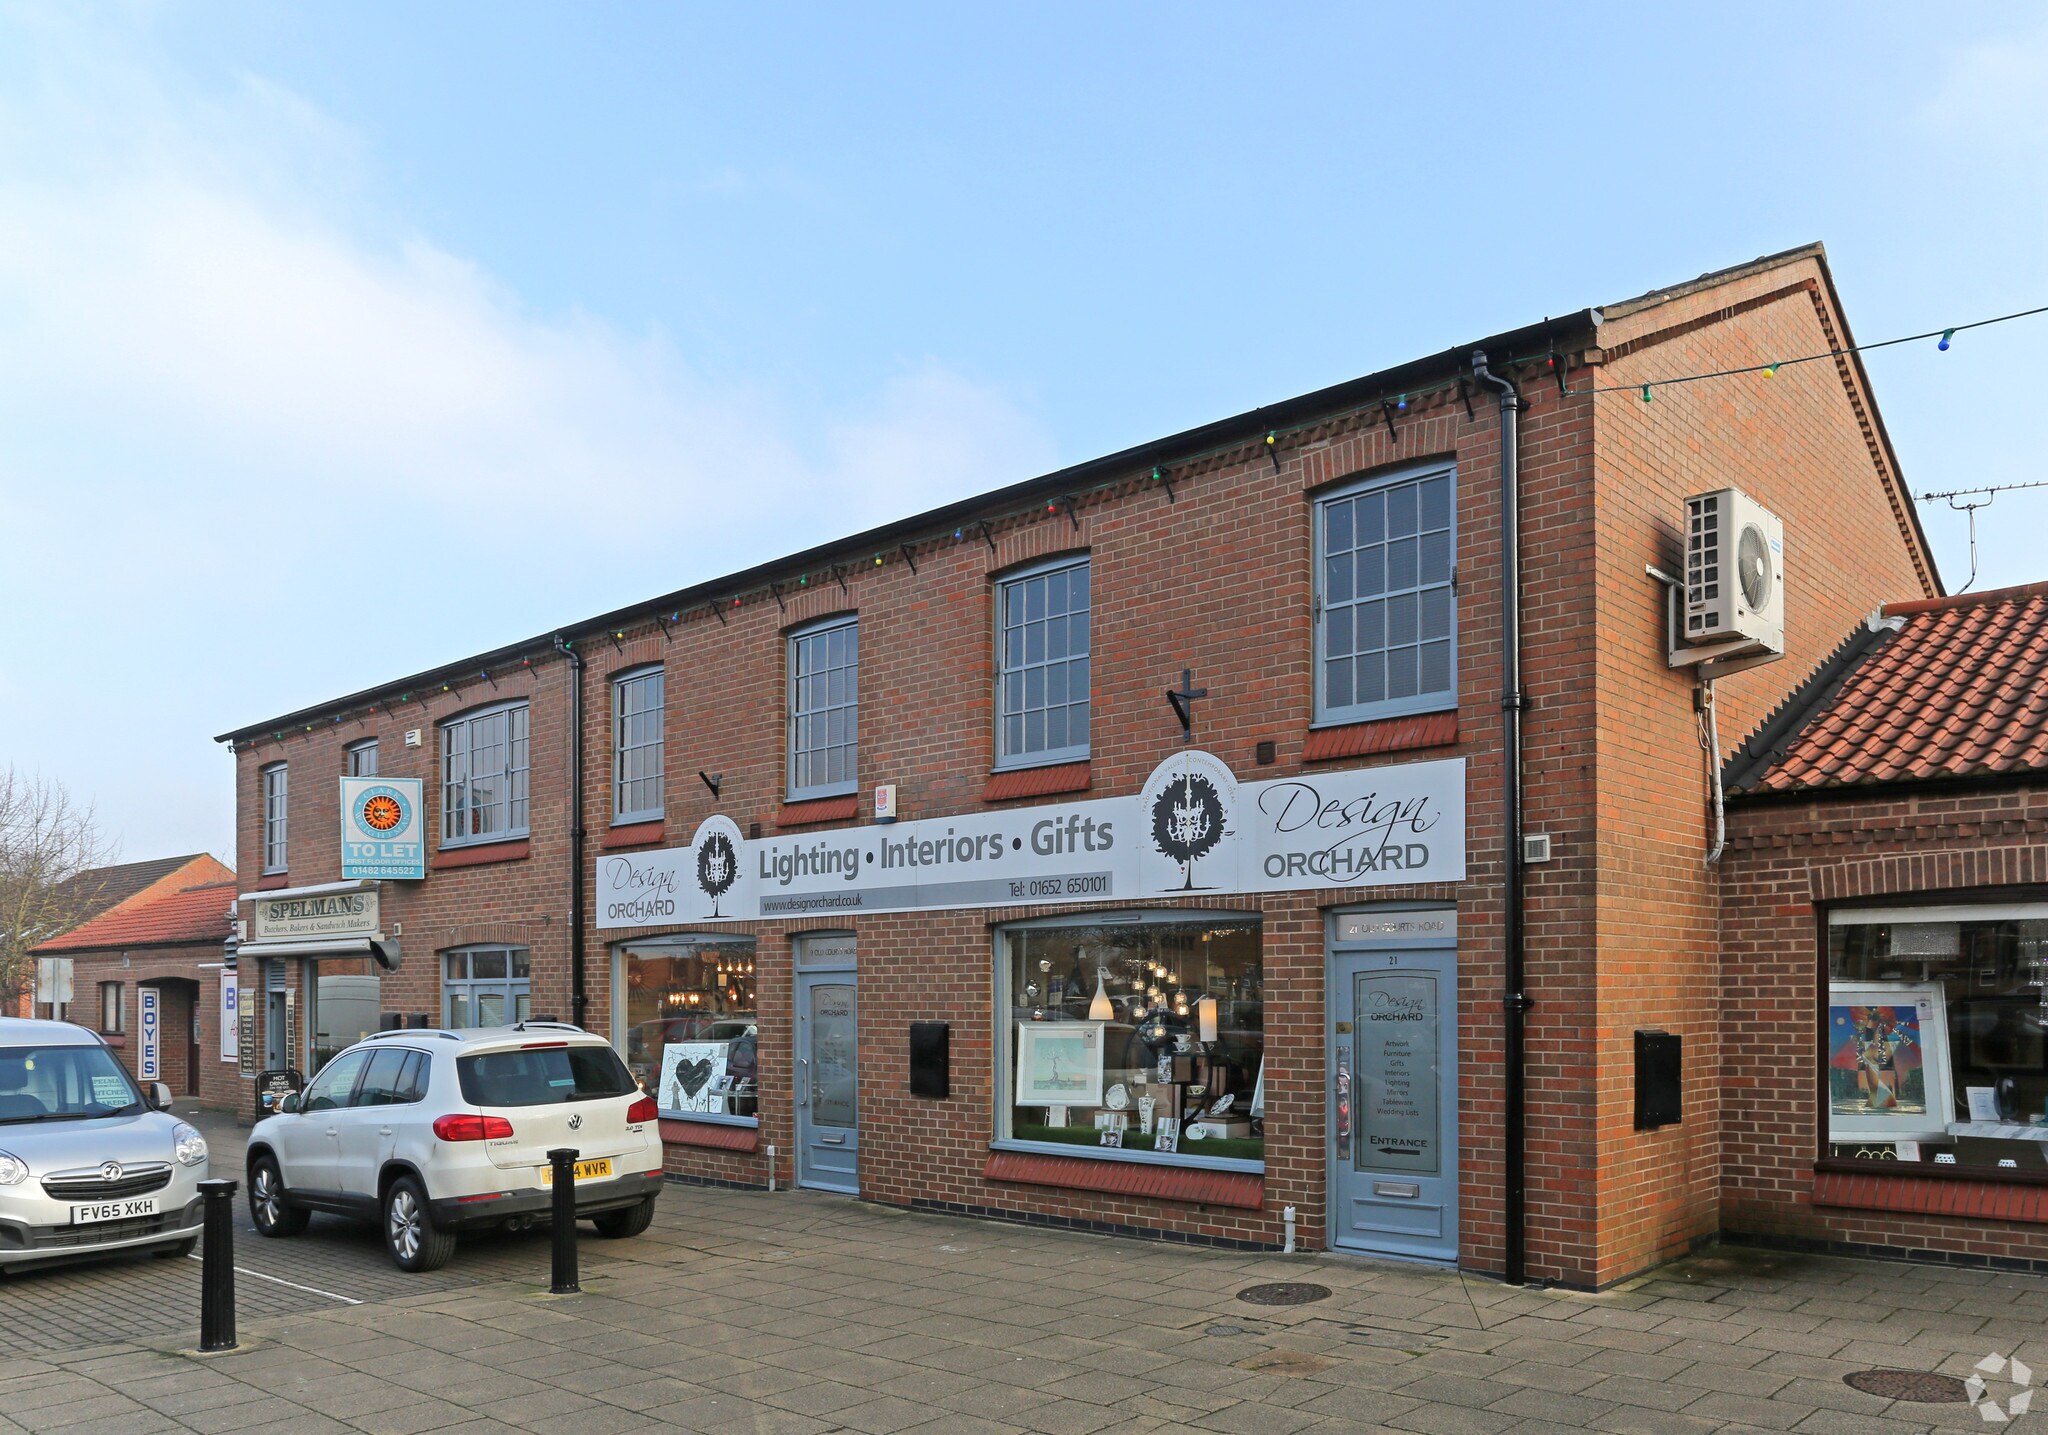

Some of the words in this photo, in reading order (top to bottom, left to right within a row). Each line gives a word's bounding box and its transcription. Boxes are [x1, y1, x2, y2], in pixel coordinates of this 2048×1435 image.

[363, 787, 400, 800] CLARK
[355, 812, 411, 838] WEIGHTMAN
[1259, 783, 1441, 882] Design
[350, 844, 375, 857] TO
[381, 844, 417, 857] LET
[759, 841, 859, 886] Lighting
[881, 828, 1004, 869] Interiors
[1030, 814, 1114, 856] Gifts
[1264, 843, 1430, 878] ORCHARD
[352, 867, 379, 875] 01482
[381, 866, 415, 874] 645522
[606, 857, 681, 923] Design
[764, 893, 863, 912] www.designorchard.co.uk
[1009, 882, 1025, 897] Tel:
[1030, 879, 1061, 896] 01652
[1067, 876, 1106, 894] 650101
[270, 895, 365, 919] SPELMANS
[608, 899, 675, 919] ORCHARD
[264, 925, 288, 933] Butchers,
[290, 923, 309, 932] Bakers
[317, 920, 346, 930] Sandwich
[347, 919, 370, 929] Makers
[1389, 956, 1398, 965] 21
[820, 1009, 849, 1017] ORCHARD
[1369, 991, 1425, 1024] Design
[1371, 1012, 1424, 1022] ORCHARD
[144, 995, 155, 1074] BOYES
[1385, 1079, 1410, 1088] Lighting
[1377, 1108, 1405, 1117] Wedding
[1370, 1135, 1428, 1148] ENTRANCE
[583, 1161, 607, 1176] WVR
[80, 1204, 121, 1221] FV65
[125, 1200, 153, 1216] XKH
